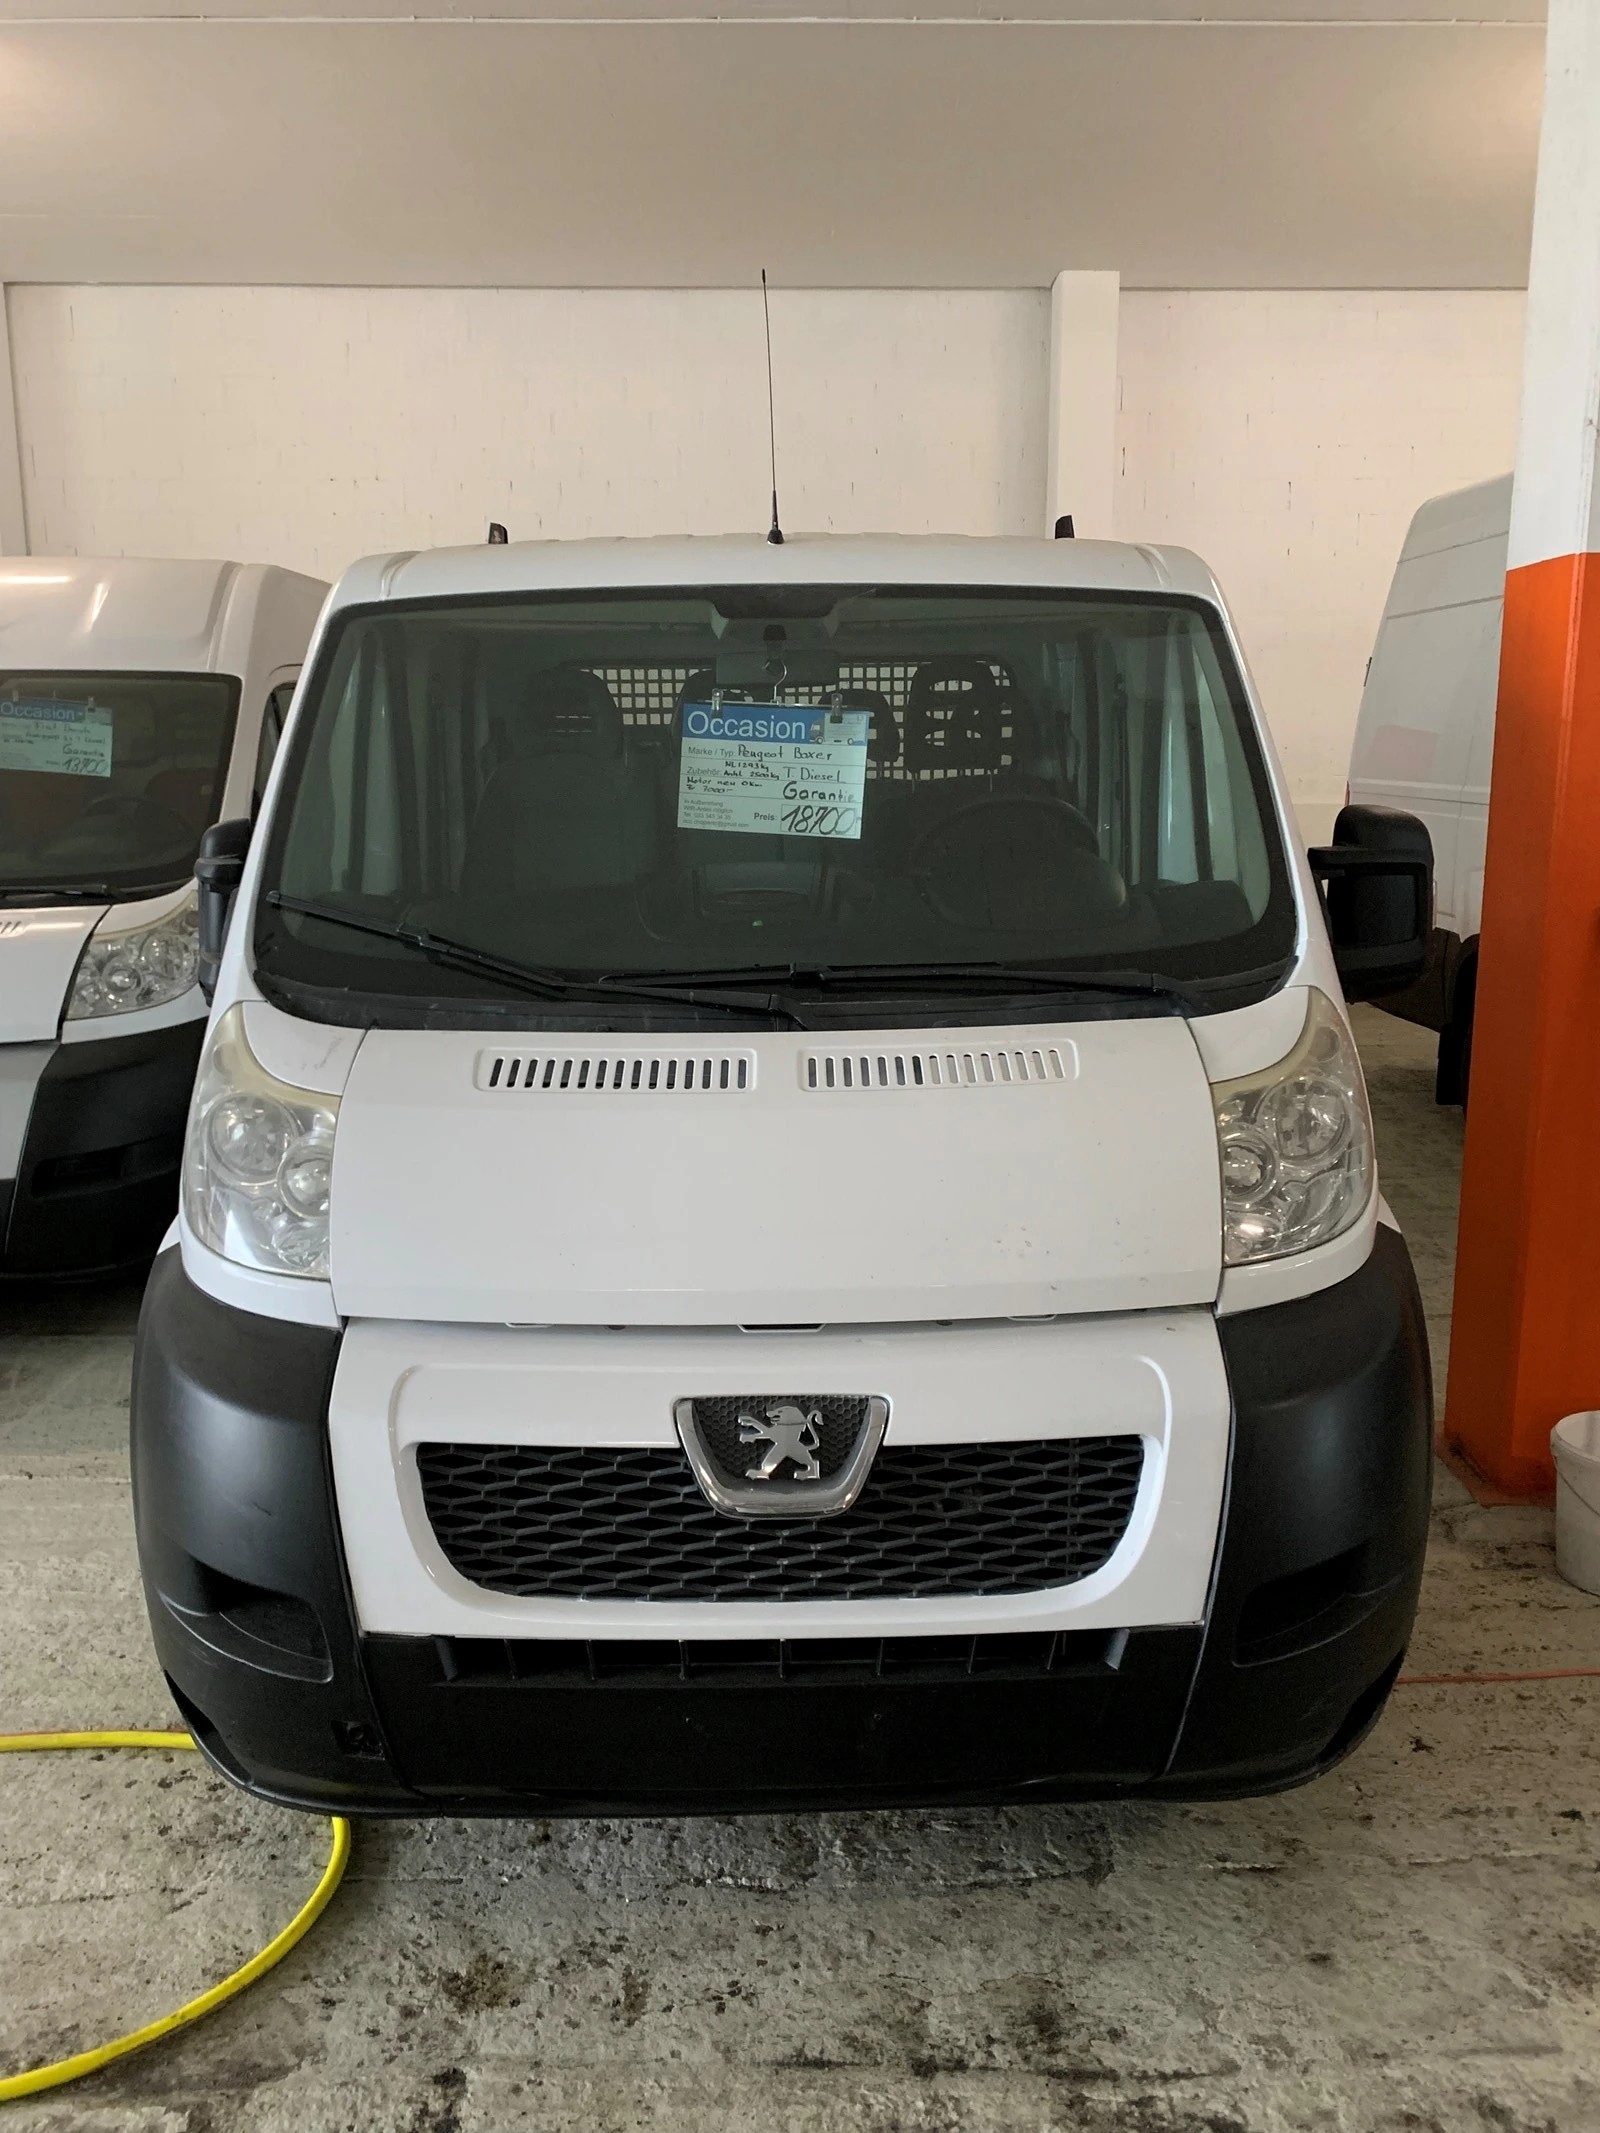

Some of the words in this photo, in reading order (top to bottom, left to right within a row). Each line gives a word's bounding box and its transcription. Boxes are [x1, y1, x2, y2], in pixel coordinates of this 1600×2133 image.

[1, 702, 75, 720] Occasion
[687, 710, 806, 740] Occasion
[688, 746, 713, 756] Marke
[737, 743, 783, 762] Peugeot
[800, 766, 846, 784] Diesel
[782, 780, 858, 803] Garantie
